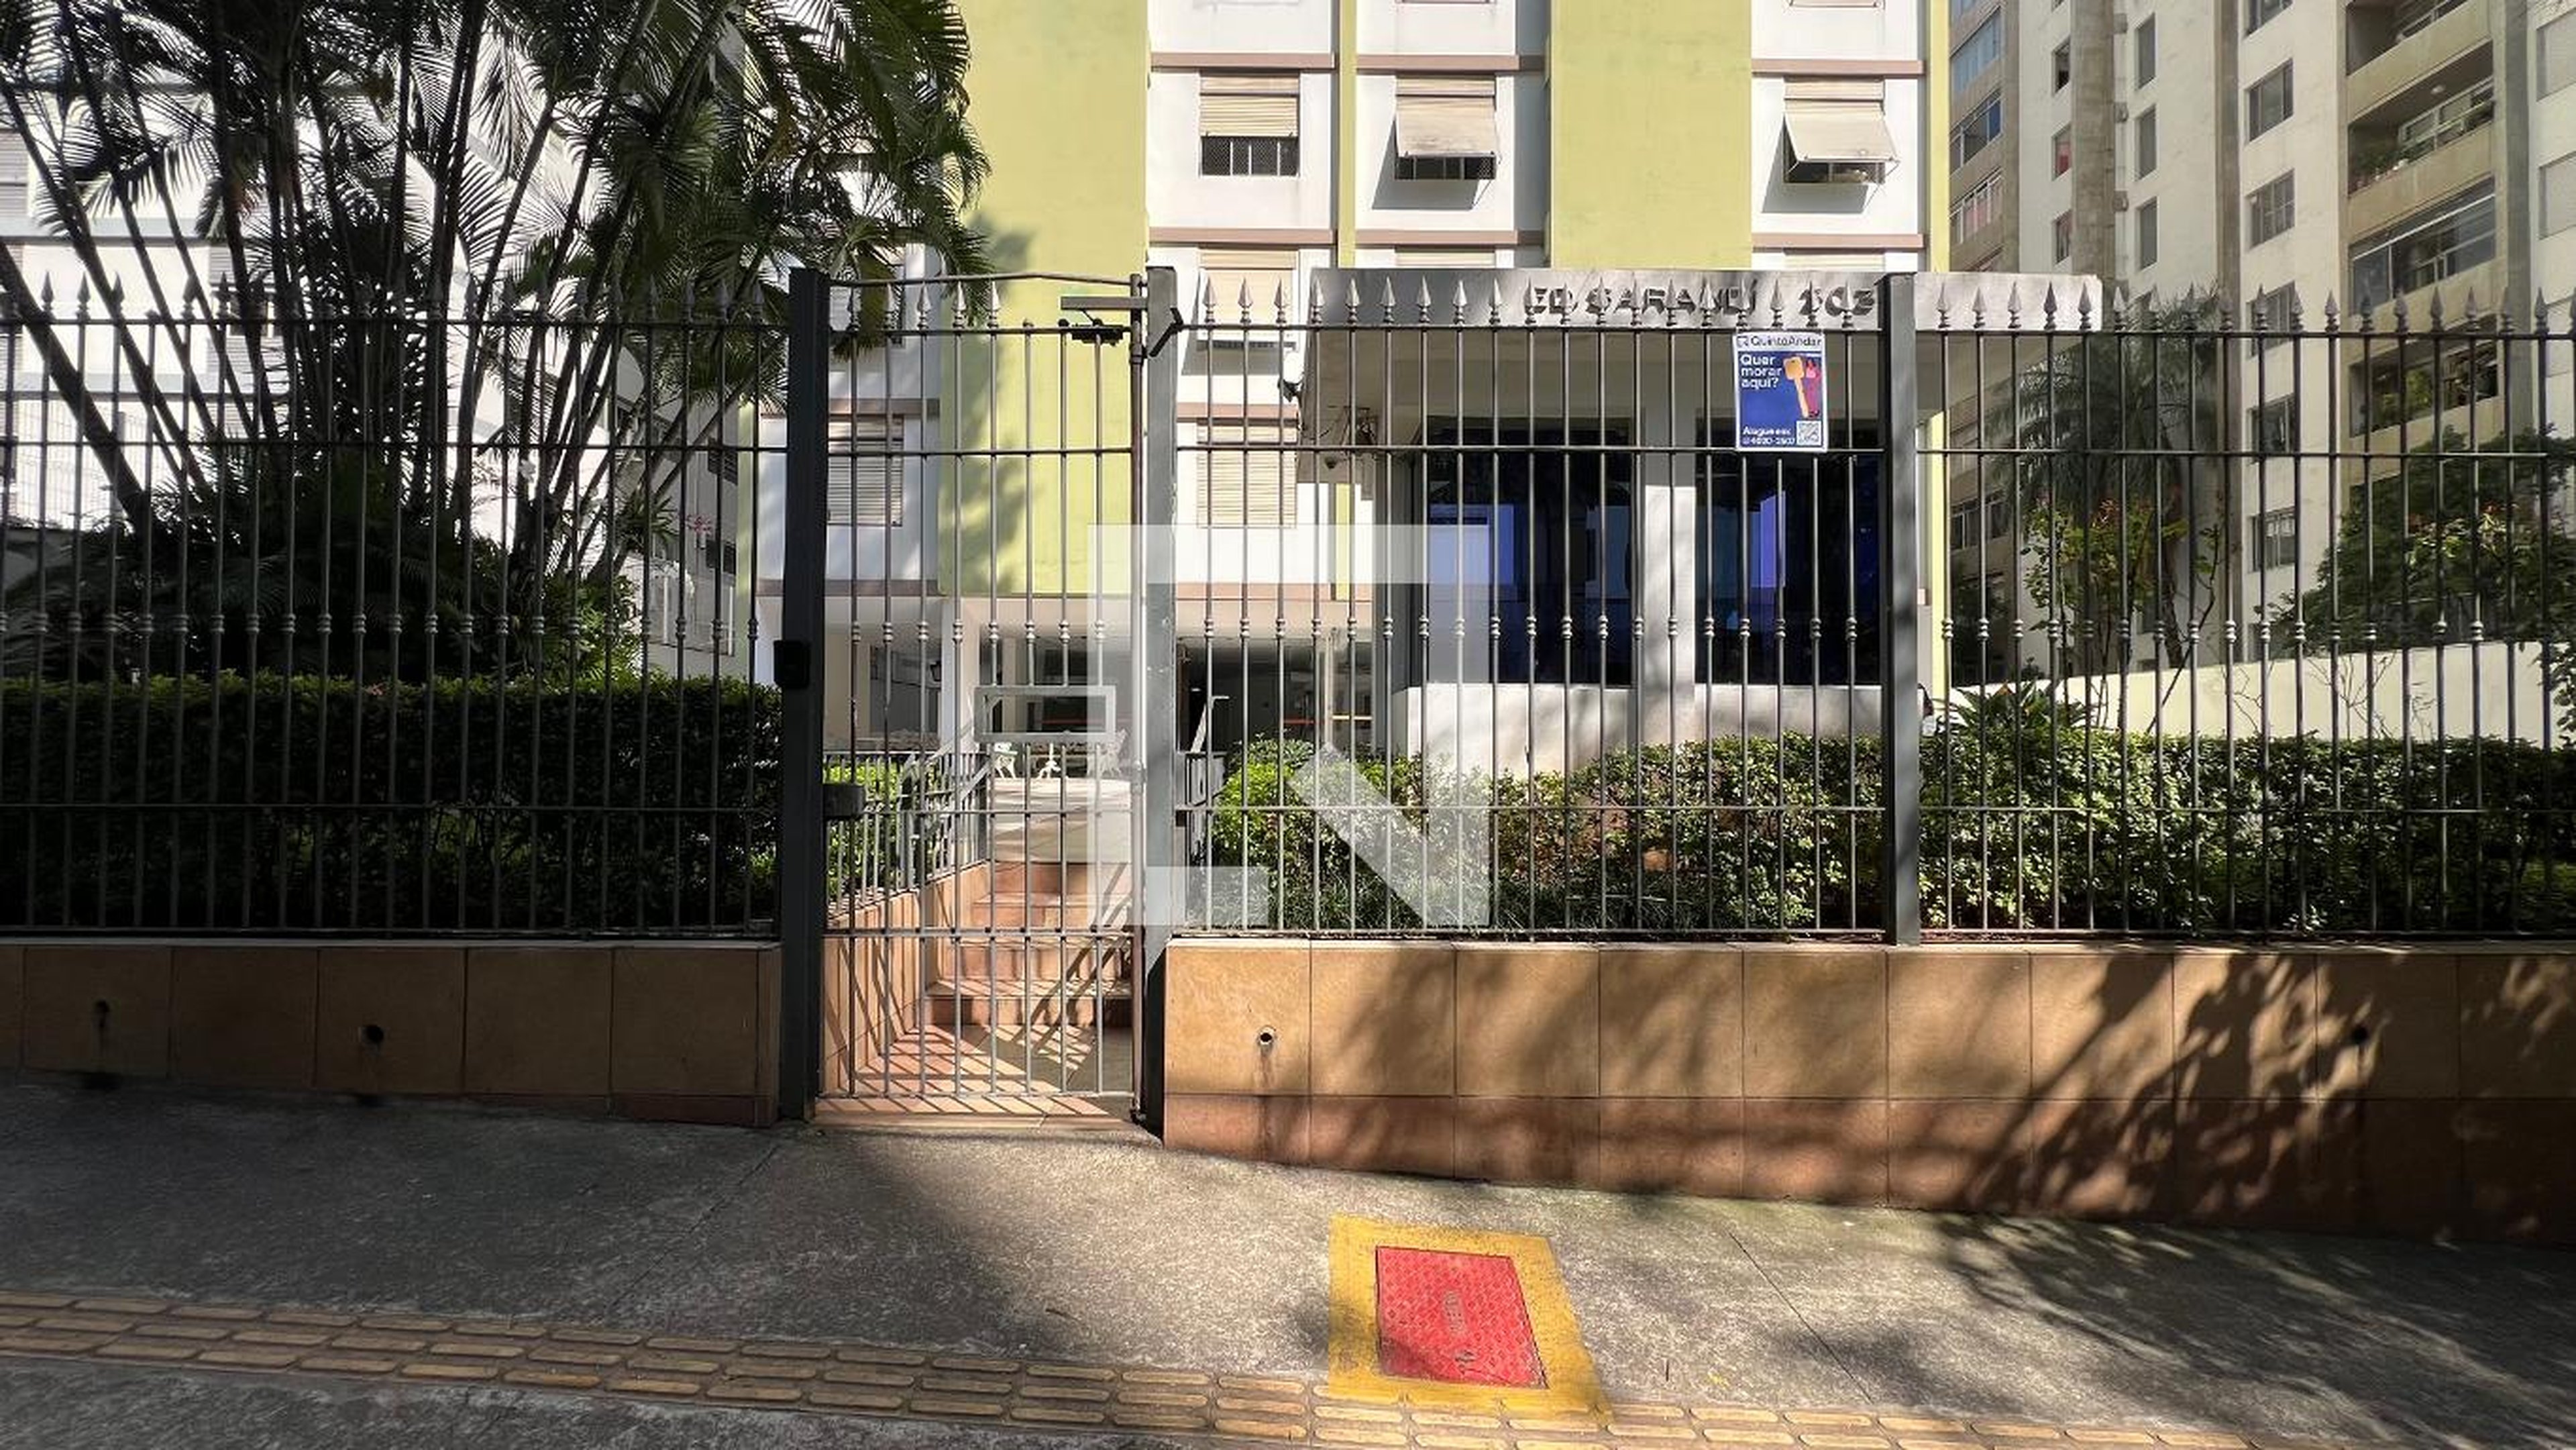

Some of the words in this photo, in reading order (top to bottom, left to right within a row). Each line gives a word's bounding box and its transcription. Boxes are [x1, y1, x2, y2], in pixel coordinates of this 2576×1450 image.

[1750, 335, 1821, 346] QuintoAndar
[1741, 367, 1782, 376] morar
[1741, 377, 1779, 390] aqui?
